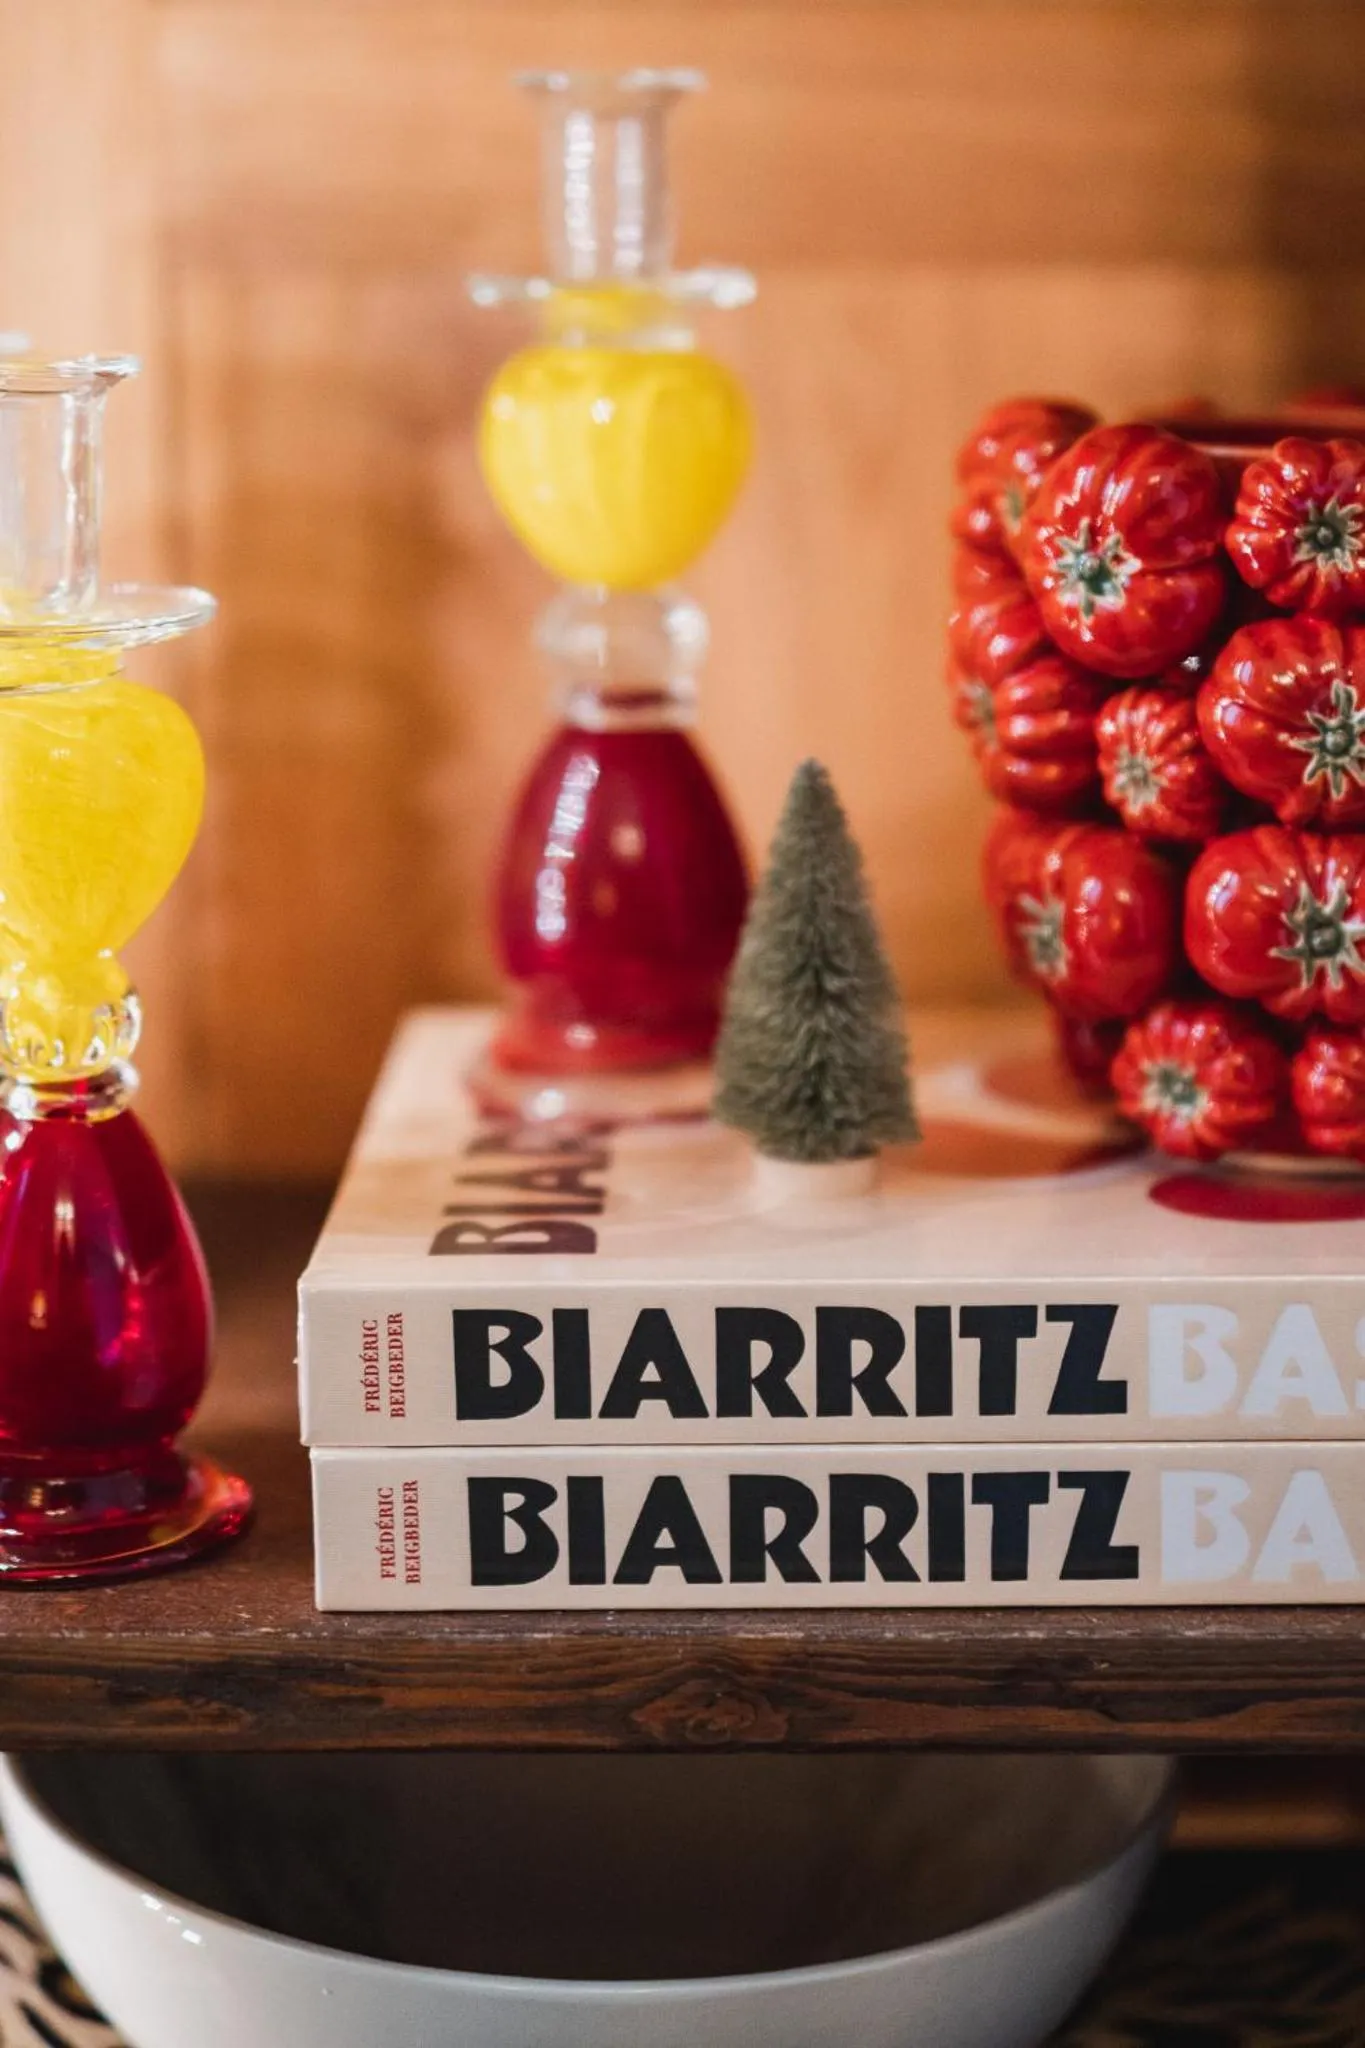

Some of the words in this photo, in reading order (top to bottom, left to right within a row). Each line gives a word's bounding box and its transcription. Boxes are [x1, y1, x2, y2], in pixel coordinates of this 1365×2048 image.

[360, 1319, 381, 1413] FRÉDÉRIC
[387, 1312, 406, 1418] BEIGBEDER
[452, 1304, 1128, 1421] BIARRITZ
[1148, 1303, 1365, 1417] BA
[376, 1487, 397, 1580] FRÉDÉRIC
[403, 1480, 422, 1585] BEIGBEDER
[466, 1470, 1140, 1586] BIARRITZ
